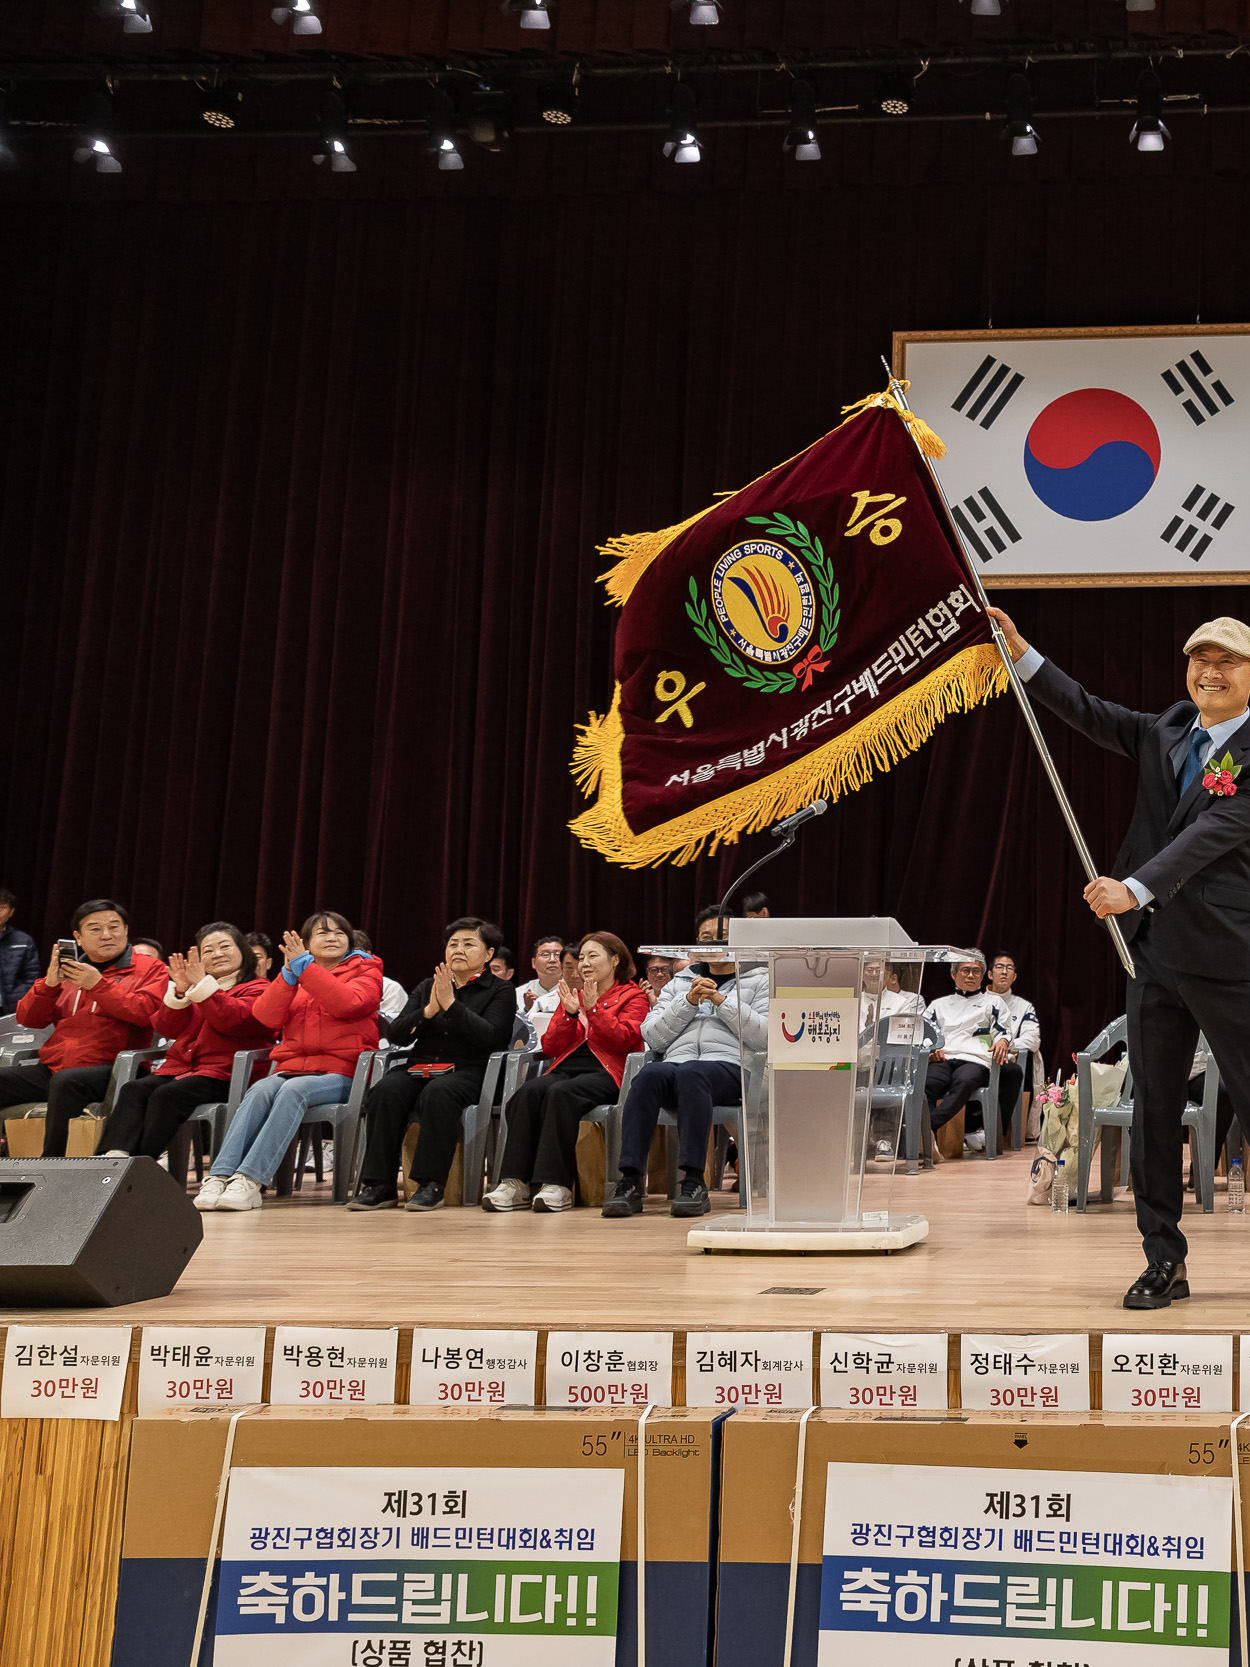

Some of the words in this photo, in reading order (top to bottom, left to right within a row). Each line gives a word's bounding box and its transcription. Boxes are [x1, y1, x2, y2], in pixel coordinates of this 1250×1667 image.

[718, 548, 742, 577] LIVING
[744, 544, 784, 560] SPORTS
[655, 670, 706, 729] 우
[844, 490, 907, 547] 승
[712, 578, 730, 623] PEOPLE
[807, 1022, 841, 1043] 행복광진
[15, 1345, 77, 1366] 김한설
[80, 1356, 120, 1366] 자문위원
[151, 1345, 213, 1367] 박태윤
[215, 1356, 254, 1366] 자문위원
[284, 1345, 344, 1368] 박용현
[347, 1358, 387, 1368] 자문위원
[422, 1347, 483, 1369] 나봉연
[486, 1359, 527, 1369] 행정감사
[562, 1350, 625, 1372] 이창훈
[627, 1361, 658, 1371] 협회장
[696, 1350, 760, 1372] 김혜자
[762, 1361, 803, 1371] 회계감사
[830, 1352, 894, 1374] 신학균
[897, 1363, 937, 1374] 자문위원
[970, 1353, 1036, 1375] 정태수
[1038, 1363, 1079, 1374] 자문위원
[1112, 1353, 1179, 1375] 오진환
[1181, 1365, 1222, 1375] 자문위원
[31, 1378, 98, 1399] 30만원
[166, 1378, 232, 1399] 30만원
[299, 1380, 365, 1401] 30만원
[439, 1381, 504, 1402] 30만원
[568, 1384, 648, 1405] 500만원
[716, 1384, 781, 1404] 30만원
[850, 1385, 916, 1406] 30만원
[991, 1386, 1058, 1407] 30만원
[1132, 1387, 1200, 1408] 30만원
[645, 1435, 678, 1443] ULTRA
[680, 1435, 695, 1443] HD
[653, 1449, 700, 1458] Backlight
[382, 1490, 466, 1518] 제31회
[984, 1491, 1071, 1522] 제31회
[250, 1528, 399, 1550] 광진구협회장기
[412, 1528, 594, 1550] 배드민턴대회&취임
[852, 1523, 1003, 1551] 광진구협회장기
[1014, 1529, 1203, 1560] 배드민턴대회&취임
[237, 1572, 597, 1626] 축하드립니다!!
[839, 1567, 1209, 1638] 축하드립니다!!
